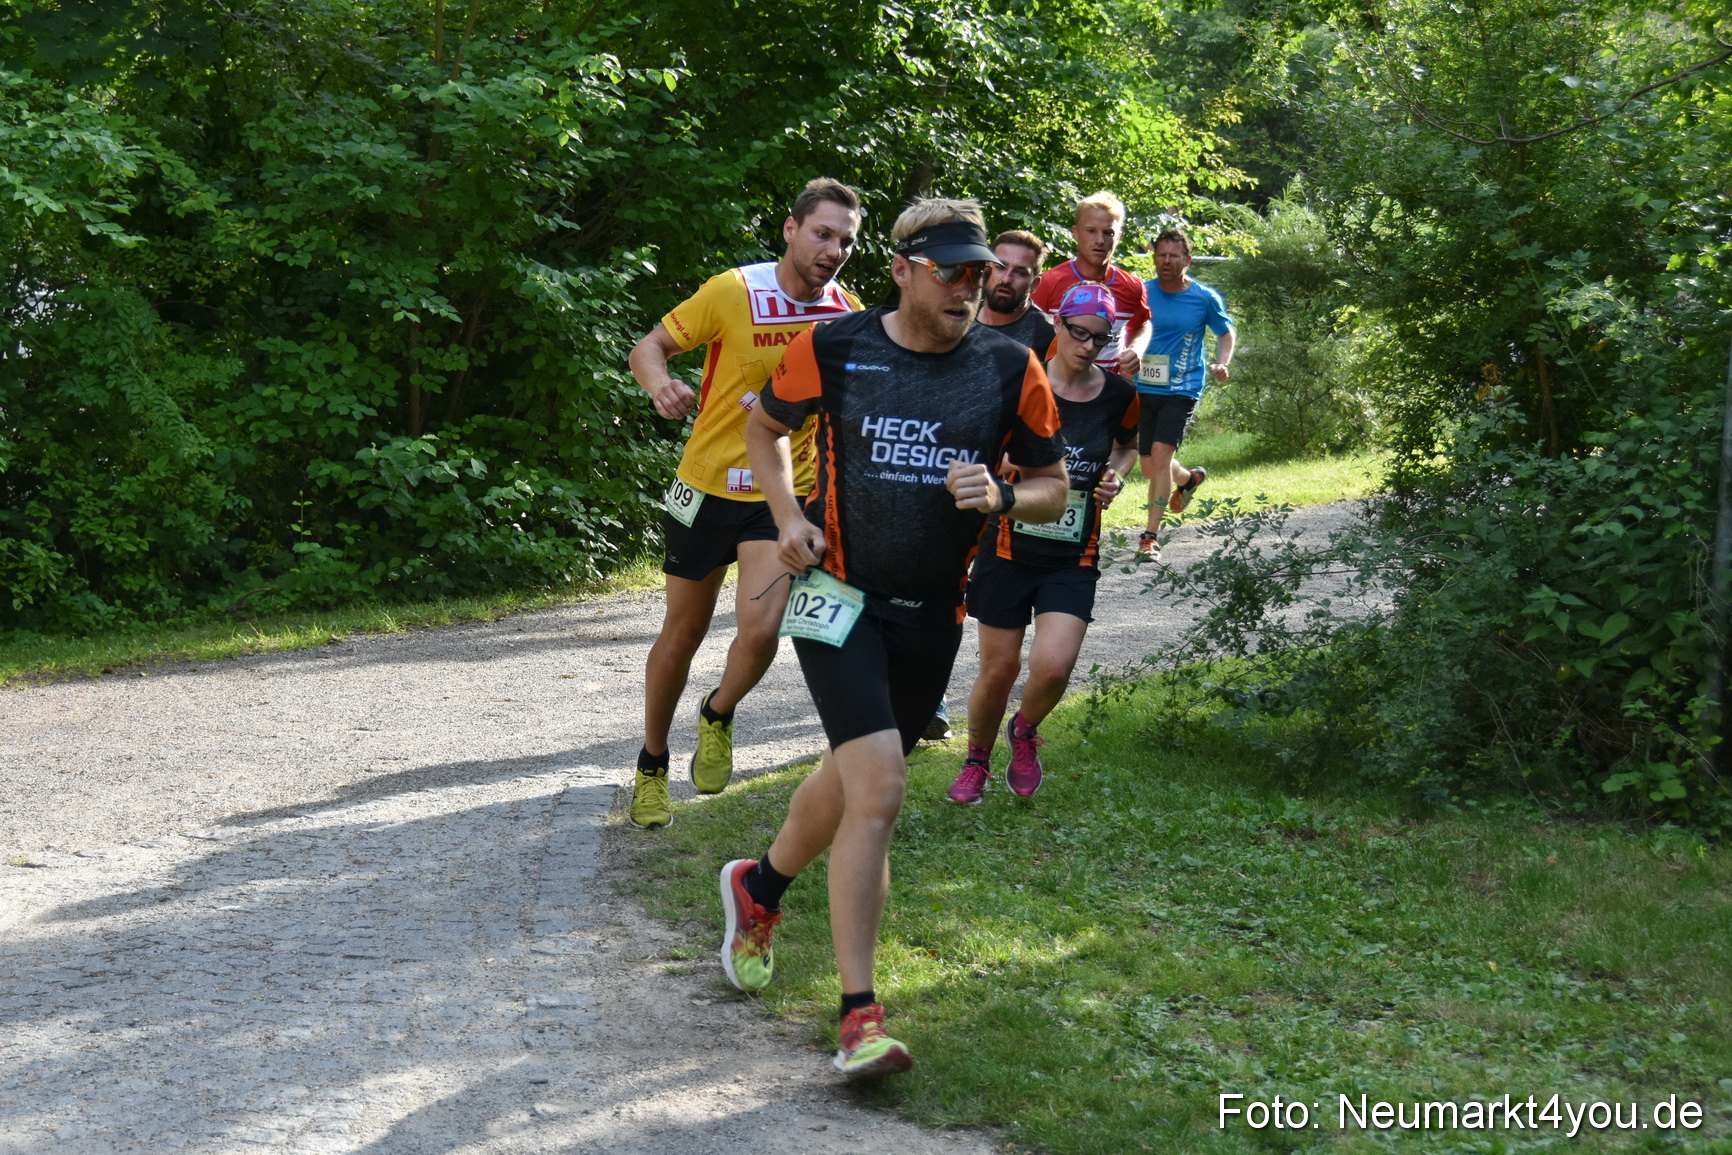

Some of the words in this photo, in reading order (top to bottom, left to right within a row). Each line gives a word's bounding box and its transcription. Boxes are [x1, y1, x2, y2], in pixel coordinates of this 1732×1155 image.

[1142, 367, 1161, 379] 9105
[861, 415, 942, 443] HECK
[870, 441, 980, 470] DESIGN
[788, 591, 843, 624] 1021
